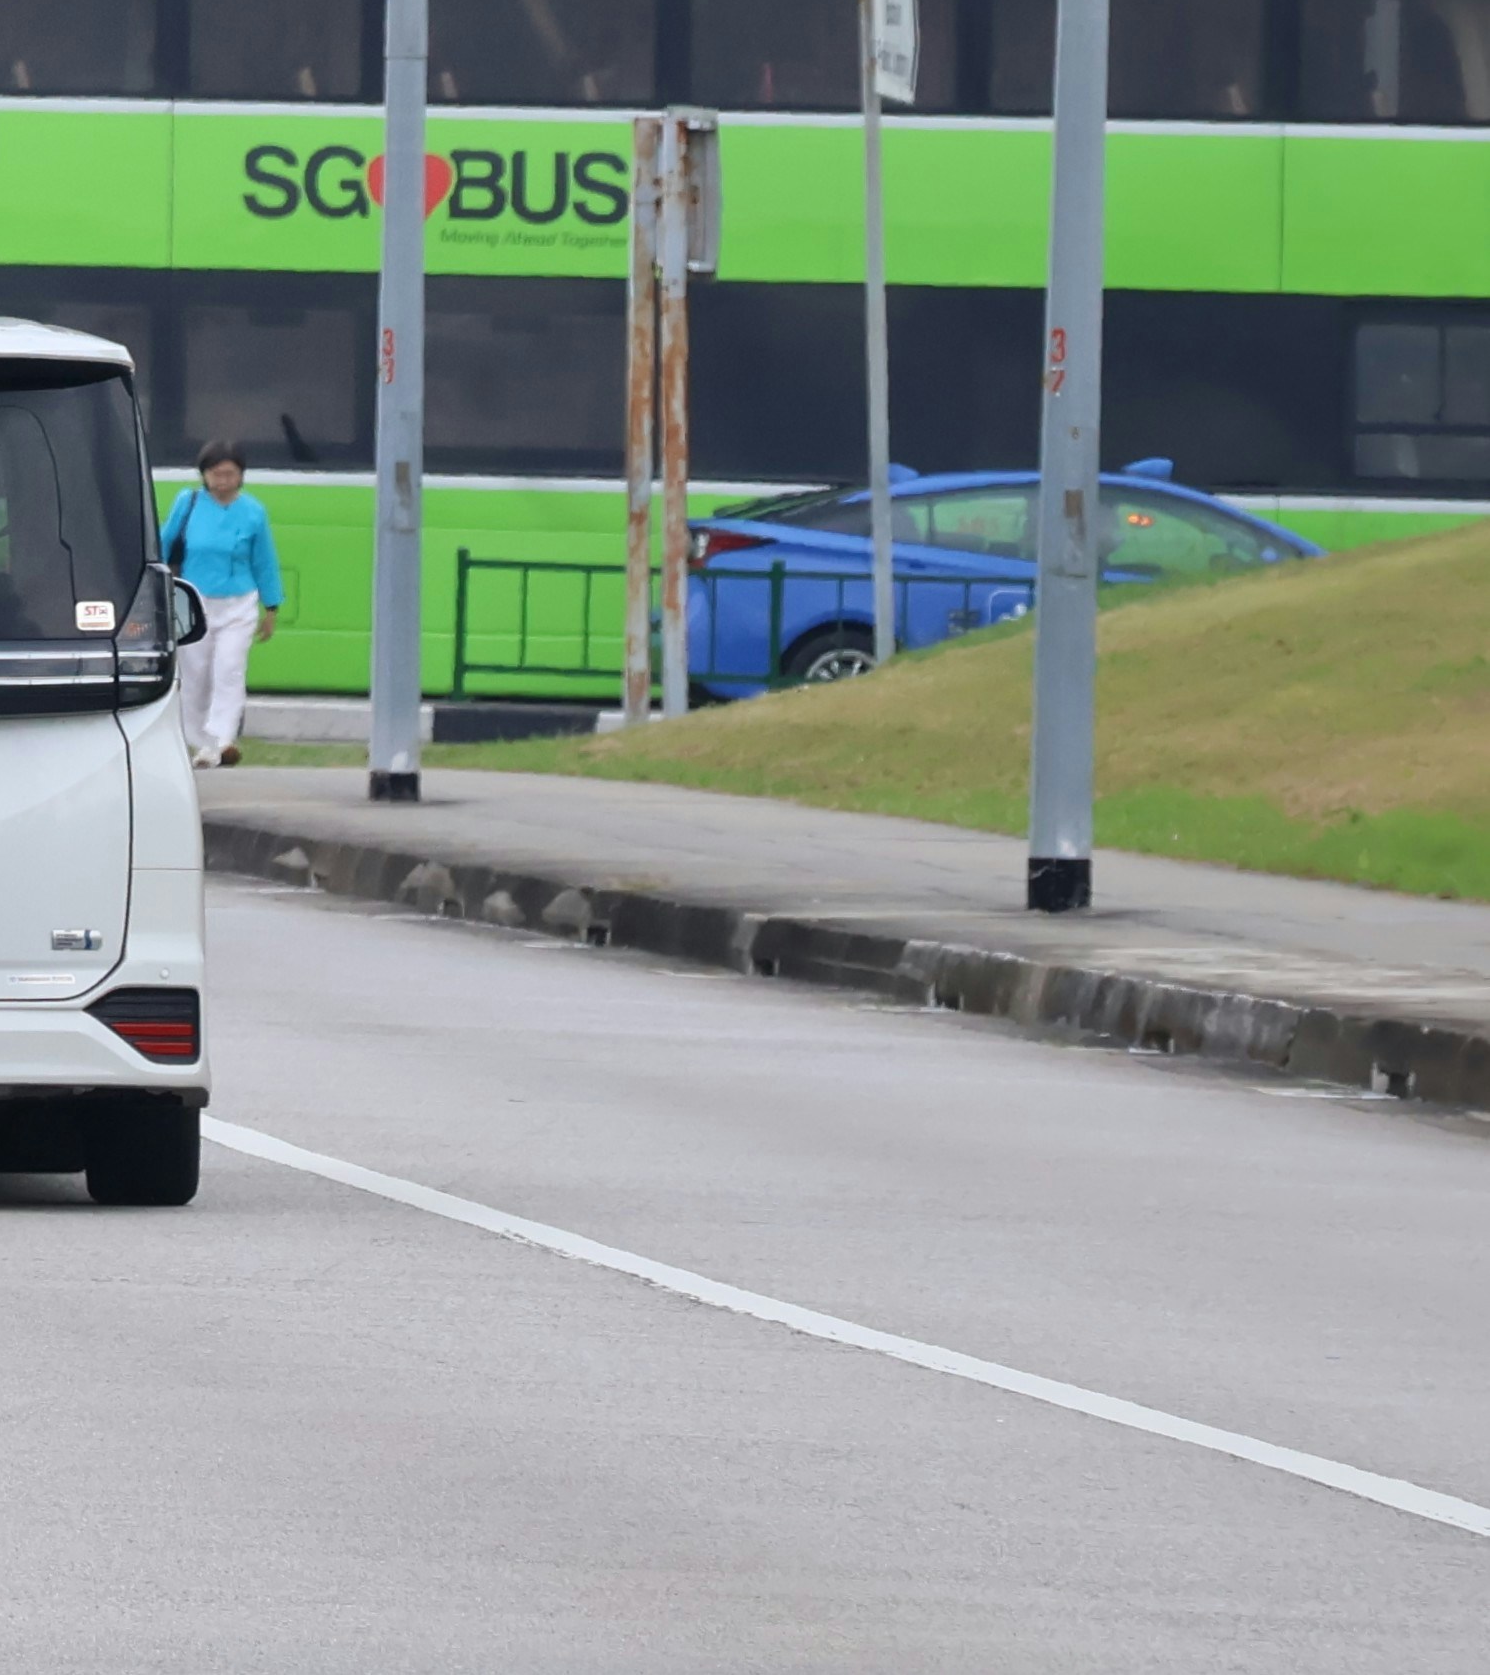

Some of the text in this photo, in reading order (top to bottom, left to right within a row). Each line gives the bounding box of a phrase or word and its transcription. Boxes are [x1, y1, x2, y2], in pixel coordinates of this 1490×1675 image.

[242, 144, 630, 225] SG BUS
[440, 228, 499, 248] Moving
[503, 230, 557, 247] Ahead
